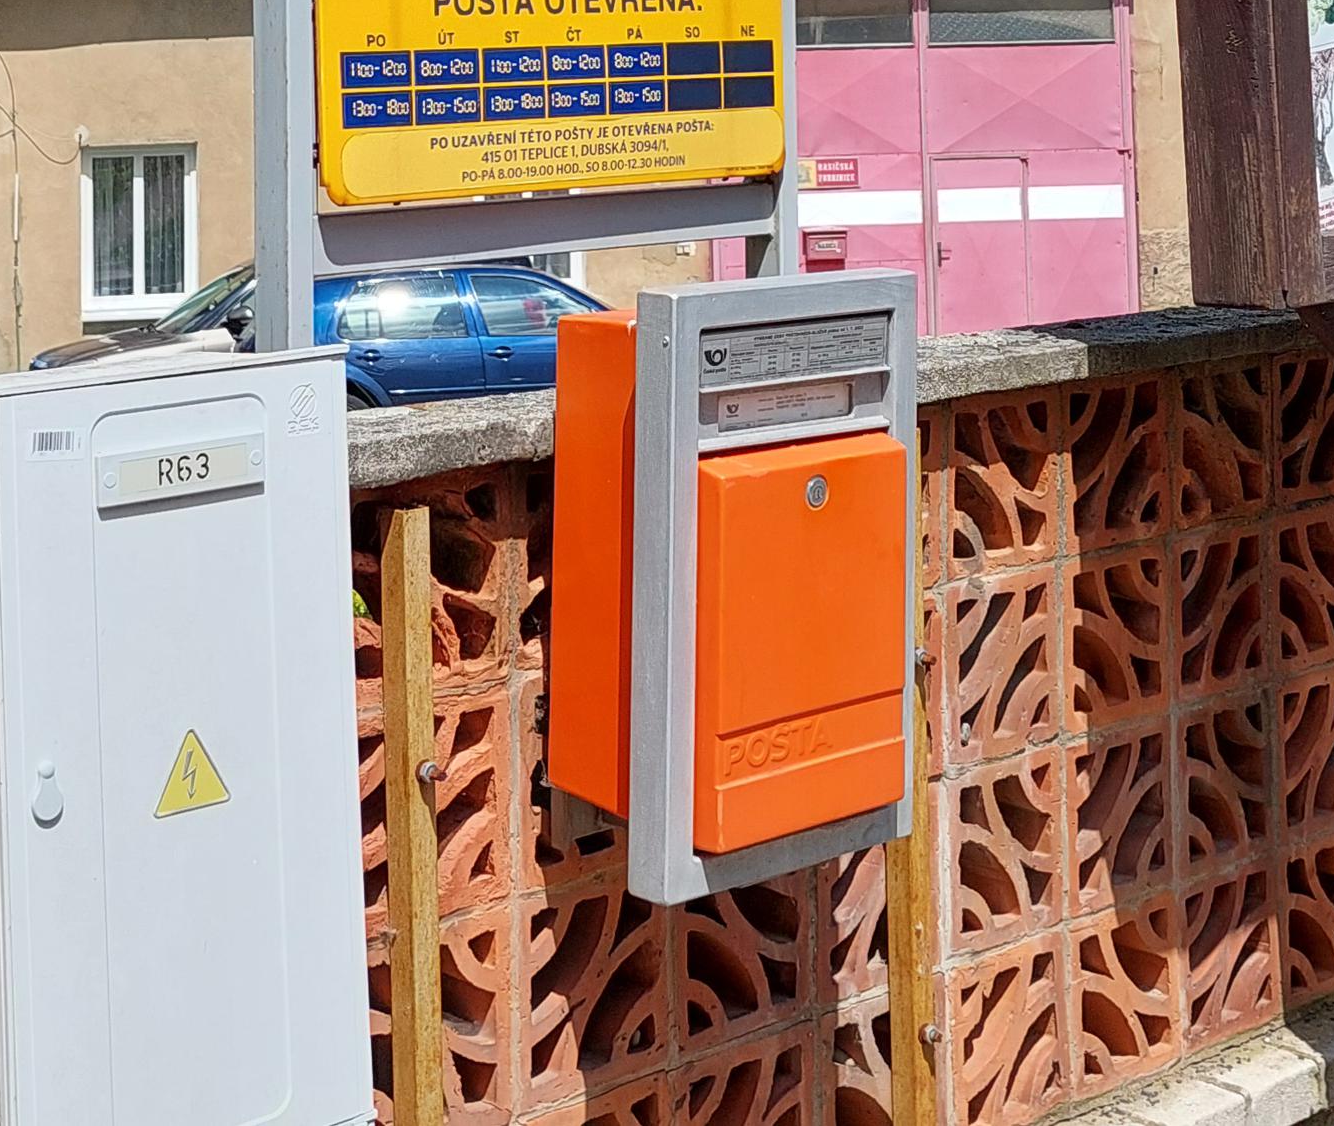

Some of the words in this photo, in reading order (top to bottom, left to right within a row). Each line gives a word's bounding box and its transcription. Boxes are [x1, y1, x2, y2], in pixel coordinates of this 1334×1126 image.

[366, 34, 386, 47] PO
[438, 30, 455, 45] ÚT
[504, 31, 520, 43] ST
[566, 27, 582, 41] ČT
[627, 27, 643, 40] PÁ
[684, 26, 700, 38] SO
[740, 25, 756, 36] NE
[430, 137, 449, 150] PO
[452, 130, 517, 148] UZAVŘENÍ
[520, 128, 552, 144] TÉTO
[555, 126, 594, 141] POŠTY
[597, 126, 609, 139] JE
[612, 122, 674, 138] OTEVŘENA
[676, 118, 714, 134] POŠTA:
[481, 151, 501, 164] 415
[504, 149, 517, 162] 01
[520, 145, 568, 161] TEPLICE
[571, 145, 579, 158] 1,
[581, 139, 628, 156] DUBSKÁ
[630, 138, 669, 153] 3094/1,
[462, 167, 495, 183] PO-PÁ
[498, 164, 554, 179] 8.00-19.00
[556, 162, 584, 175] HOD.,
[586, 160, 600, 173] SO
[601, 157, 653, 171] 8.00-12.30
[654, 155, 686, 168] HODIN
[158, 452, 211, 486] R63
